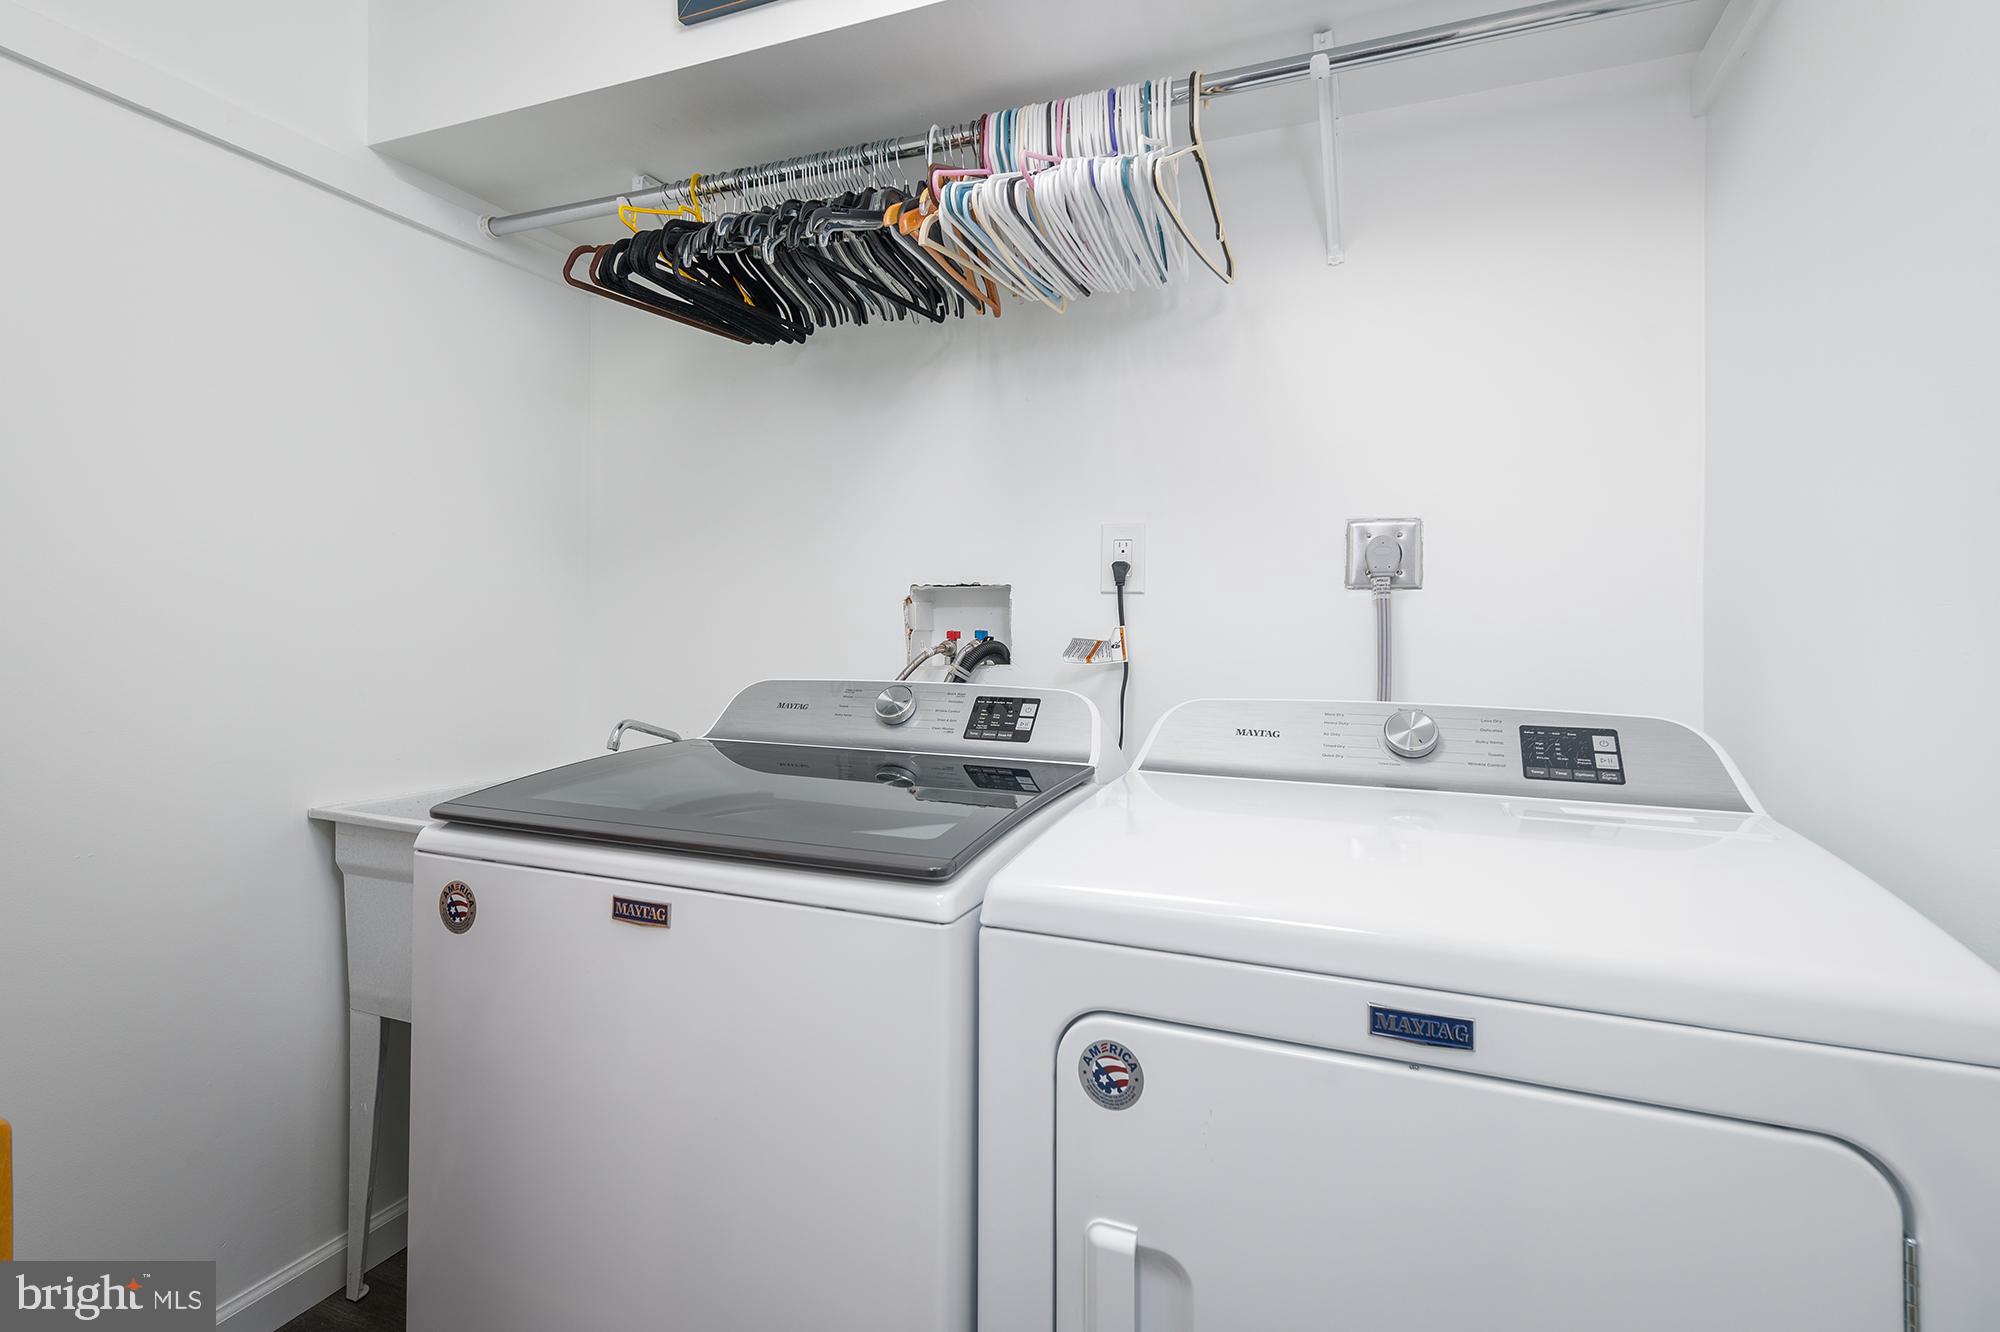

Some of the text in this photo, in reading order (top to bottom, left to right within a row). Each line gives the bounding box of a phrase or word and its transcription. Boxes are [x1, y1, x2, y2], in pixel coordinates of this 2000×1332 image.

[776, 701, 809, 711] MAYTAG
[1235, 728, 1281, 738] MAYTAG
[443, 883, 475, 908] AMERICA
[615, 901, 668, 921] MAYTAG
[1375, 1012, 1469, 1042] MAYTAG
[1083, 1042, 1138, 1073] AMERICA
